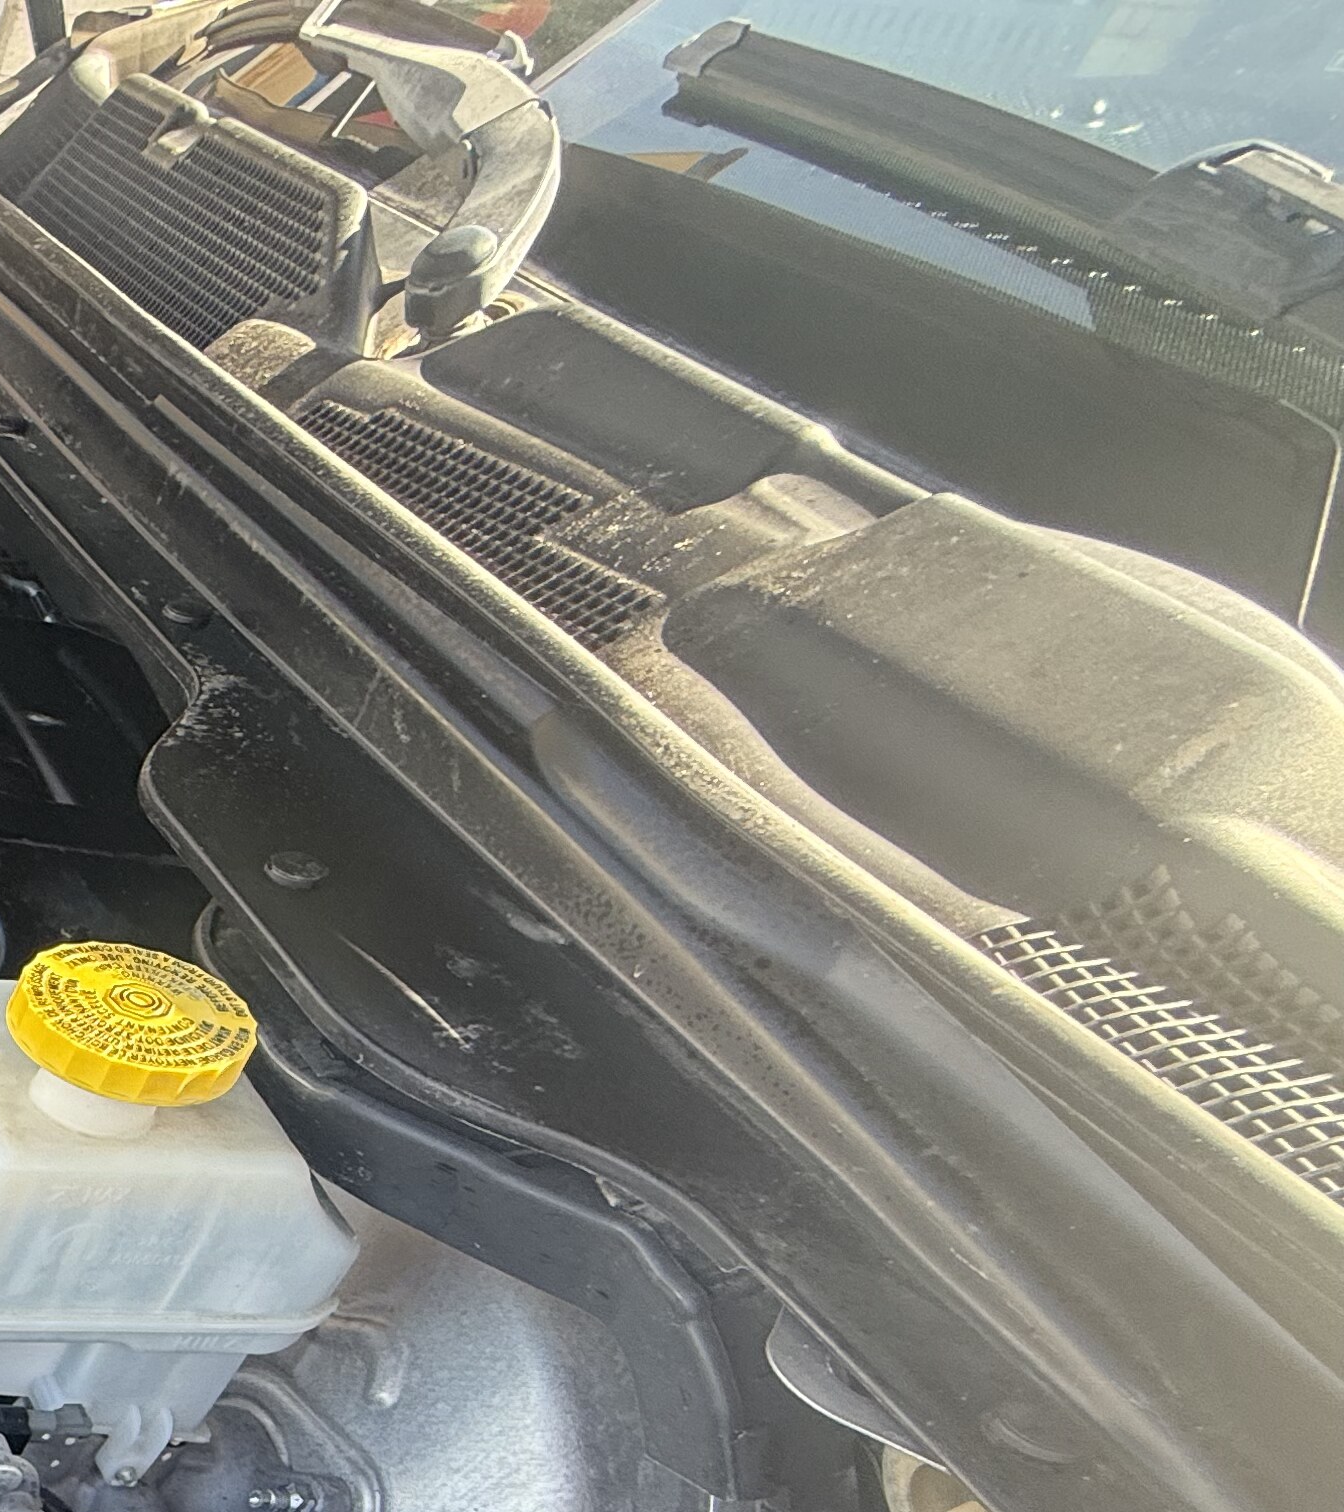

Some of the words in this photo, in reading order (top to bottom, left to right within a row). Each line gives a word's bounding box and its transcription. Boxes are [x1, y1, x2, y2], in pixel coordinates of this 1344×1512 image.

[115, 946, 159, 959] SEALED
[100, 954, 124, 962] USE
[137, 1036, 163, 1046] DOT
